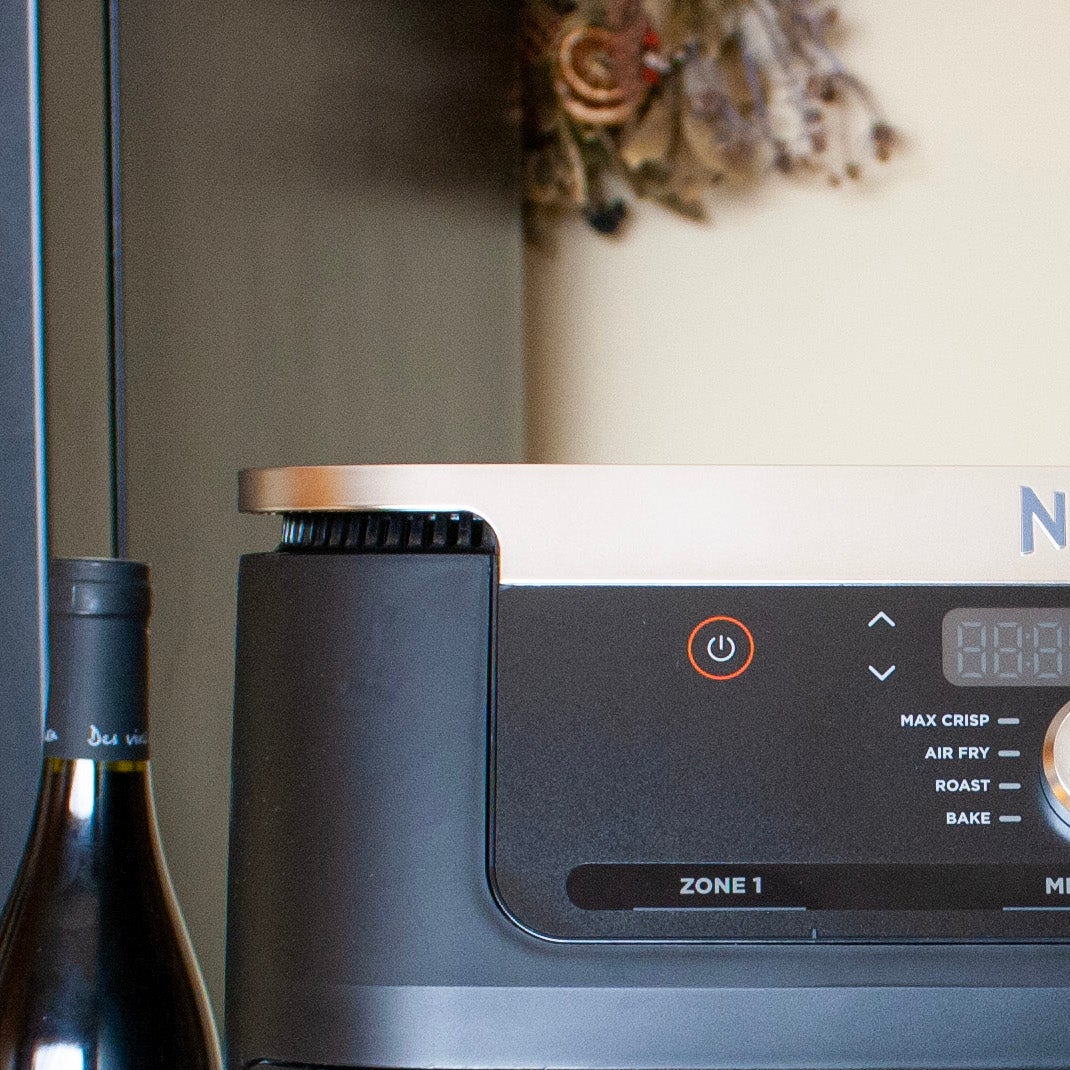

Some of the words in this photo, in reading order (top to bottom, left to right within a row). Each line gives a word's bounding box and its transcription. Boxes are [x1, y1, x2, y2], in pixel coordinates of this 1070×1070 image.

[900, 713, 937, 727] MAX
[941, 713, 990, 727] CRISP
[924, 746, 954, 760] AIR
[957, 746, 990, 760] FRY
[935, 778, 991, 792] ROAST
[946, 811, 991, 825] BAKE
[679, 876, 746, 895] ZONE
[752, 876, 763, 894] 1
